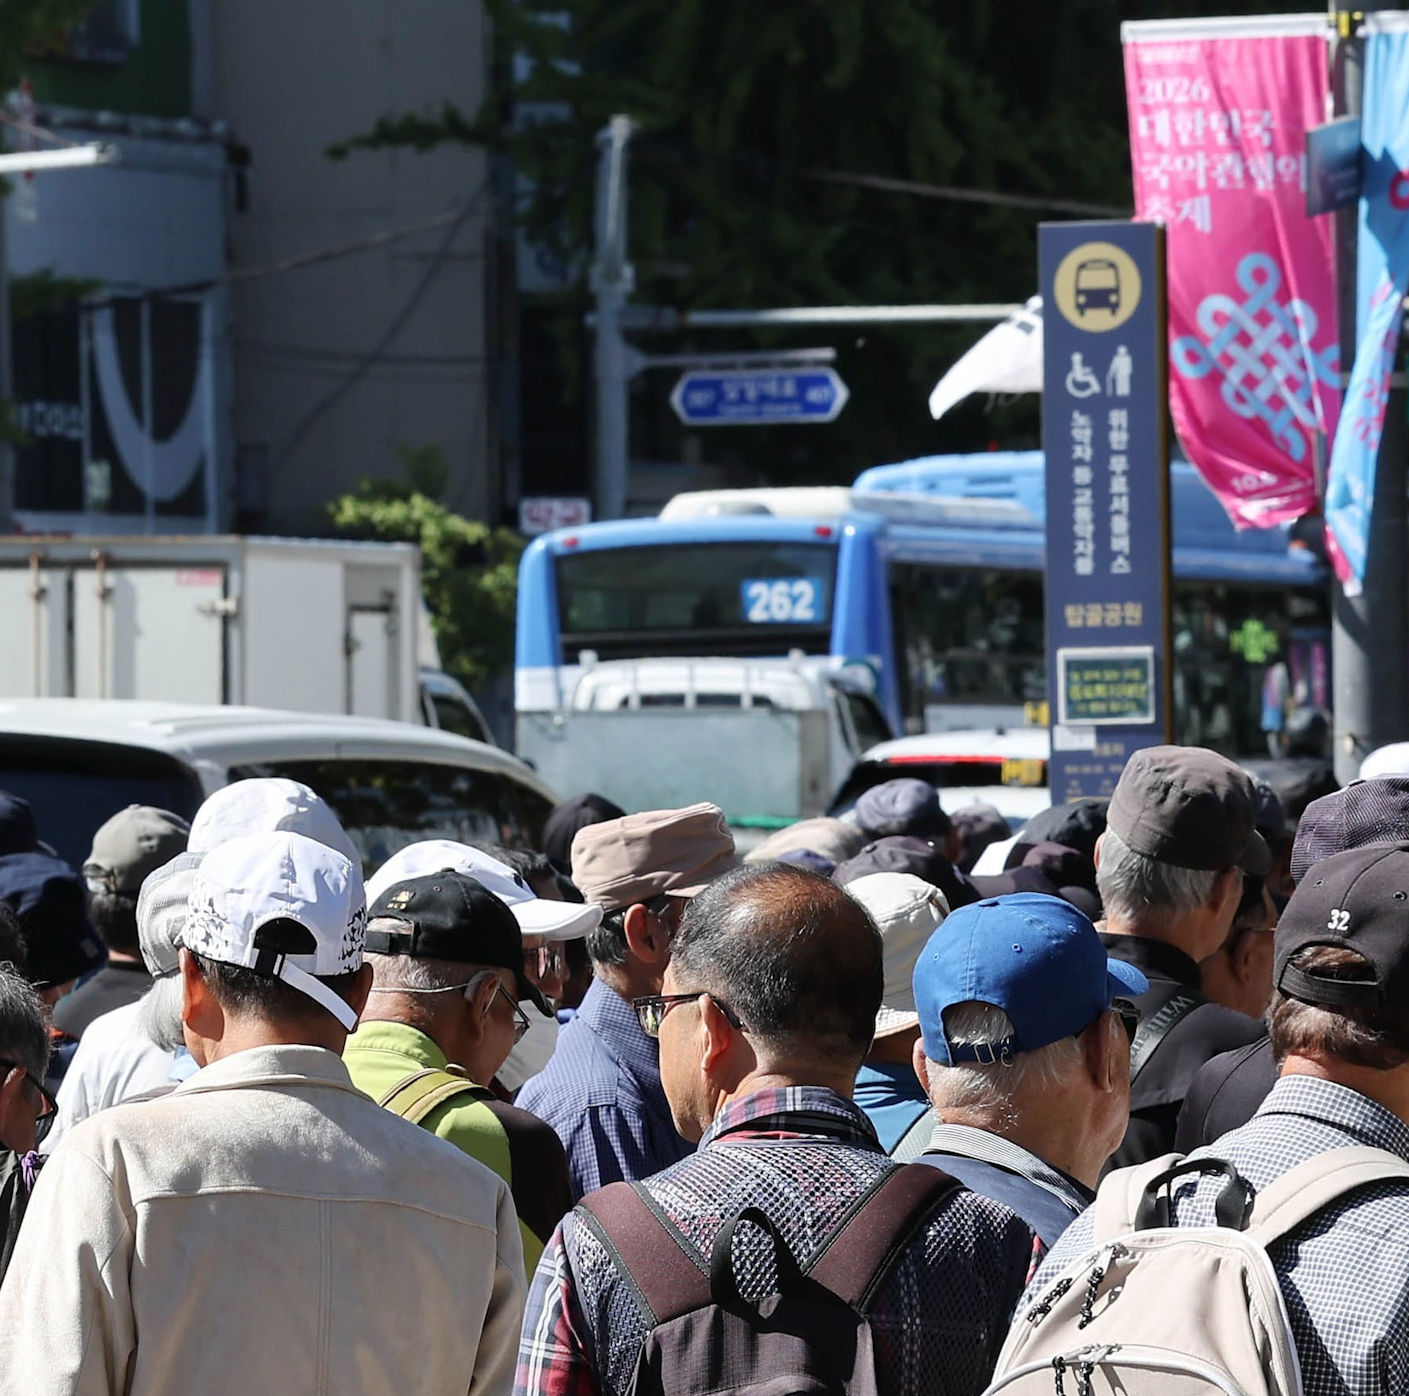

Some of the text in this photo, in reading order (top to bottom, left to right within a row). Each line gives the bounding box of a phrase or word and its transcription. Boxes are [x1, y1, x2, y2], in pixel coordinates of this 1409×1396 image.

[1141, 78, 1210, 104] 2026
[1138, 109, 1275, 147] 대한민국
[747, 580, 815, 624] 262
[1064, 602, 1143, 628] 탑골공원
[1327, 908, 1351, 932] 32
